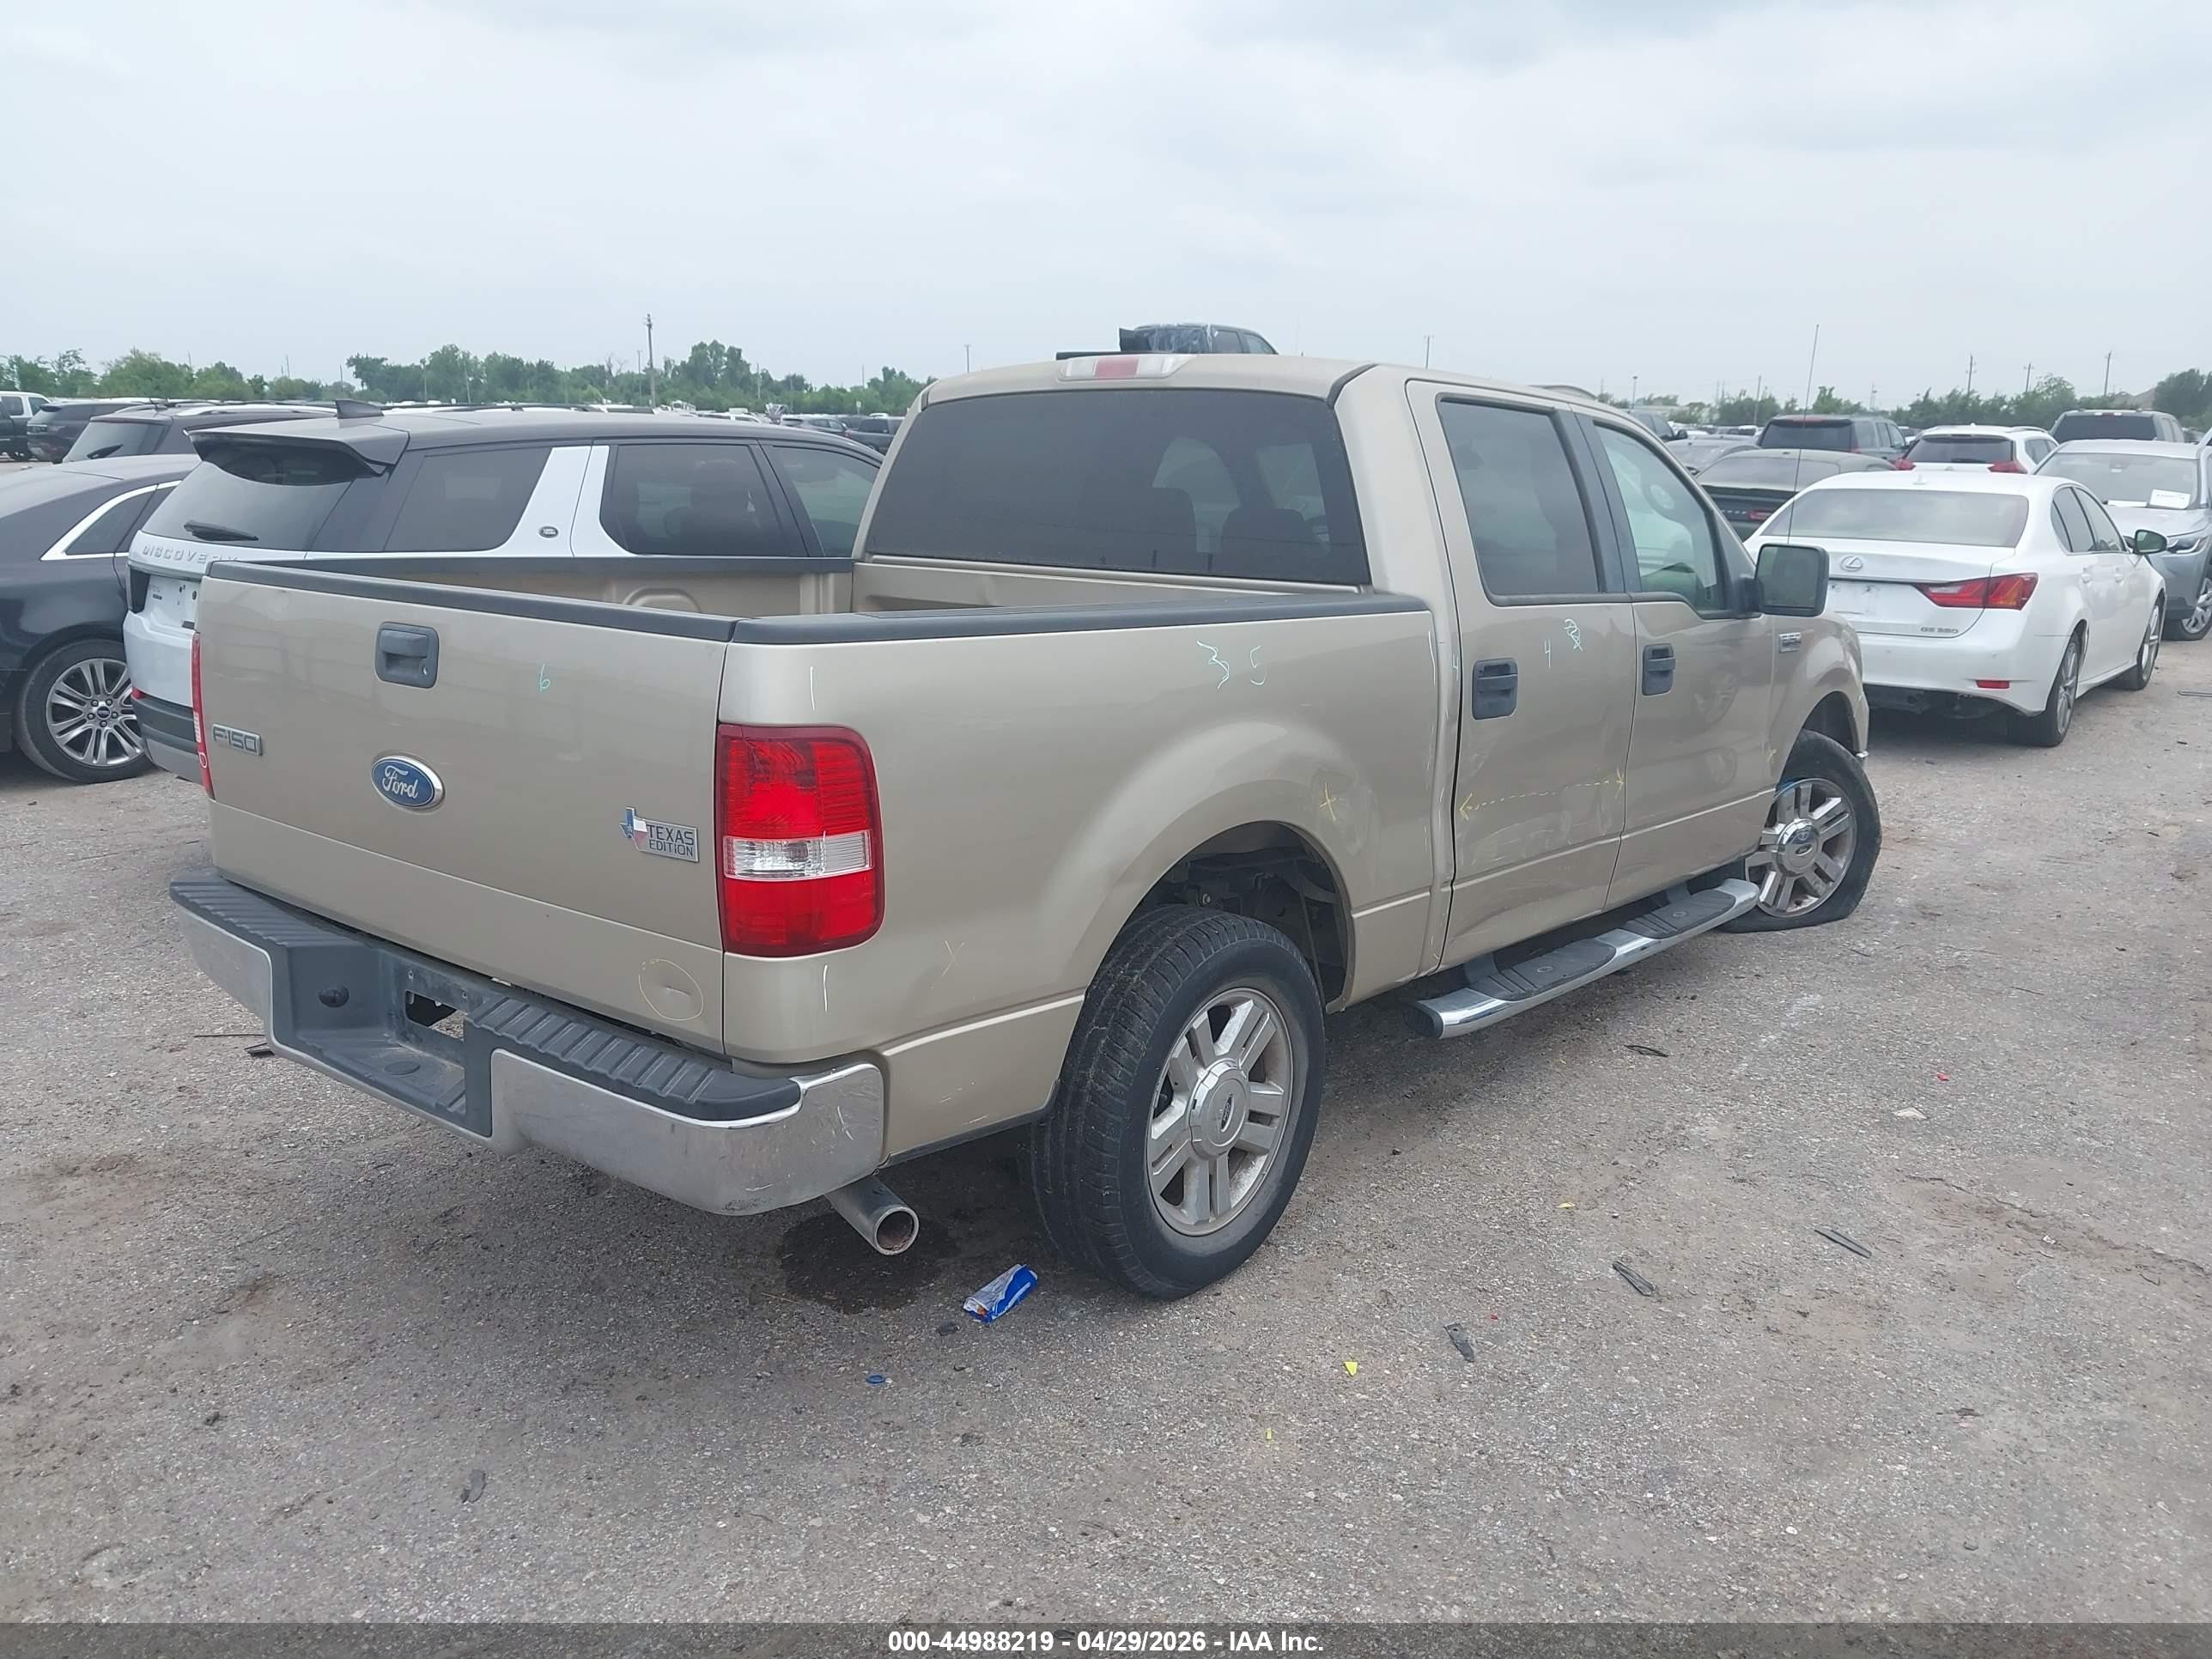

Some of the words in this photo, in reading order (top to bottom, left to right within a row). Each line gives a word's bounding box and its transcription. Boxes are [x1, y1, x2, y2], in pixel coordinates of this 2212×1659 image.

[538, 663, 551, 692] 6
[381, 764, 419, 799] Ford
[646, 823, 695, 846] TEXAS
[648, 839, 694, 858] EDITION
